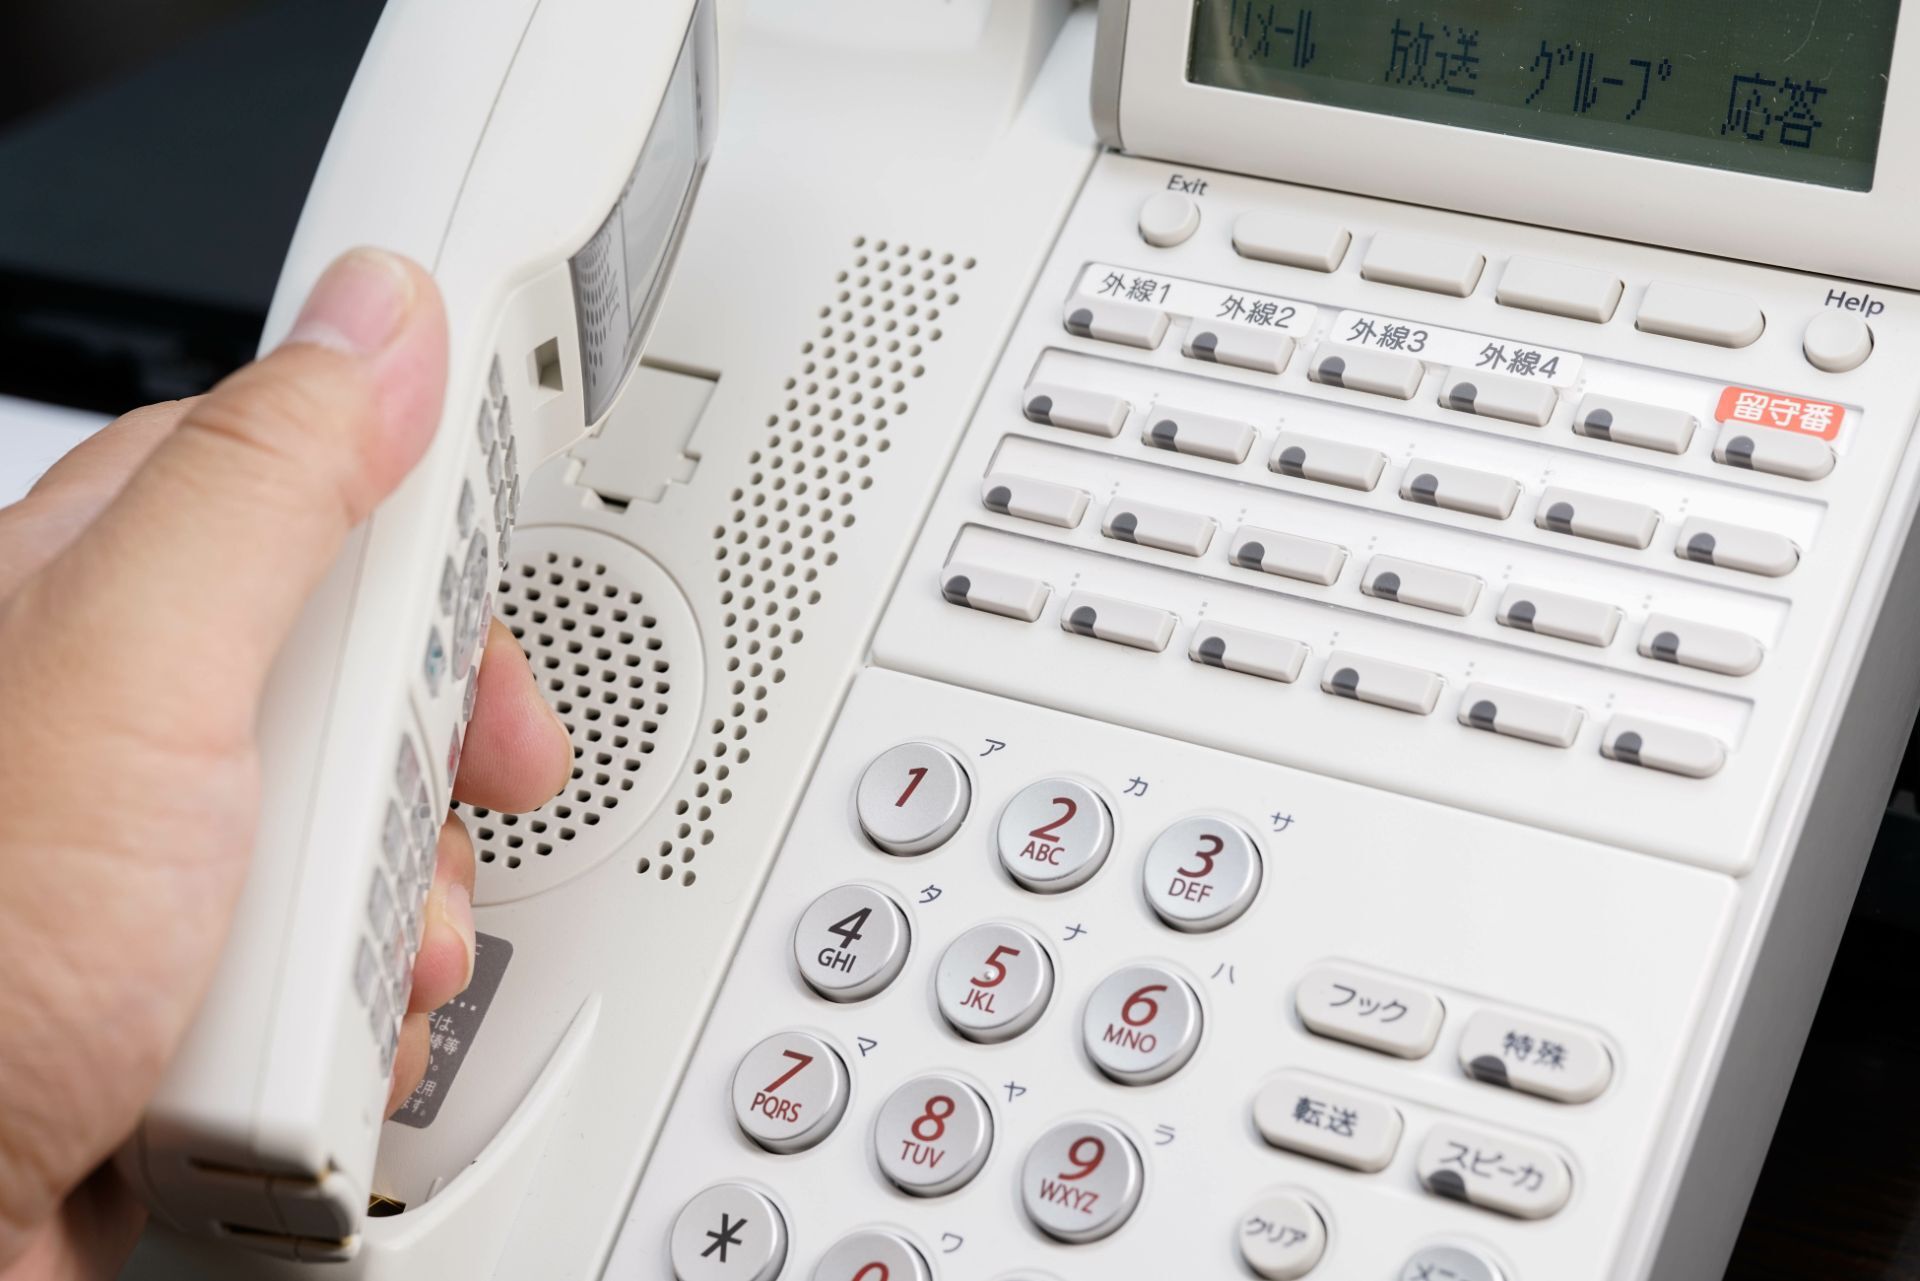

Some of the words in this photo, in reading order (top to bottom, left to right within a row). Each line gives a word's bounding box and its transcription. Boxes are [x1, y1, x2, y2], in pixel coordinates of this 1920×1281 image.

[1385, 19, 1479, 95] 放送
[1721, 73, 1827, 148] 応答
[1167, 174, 1208, 198] Exit
[1100, 271, 1172, 304] 外線1
[1824, 289, 1884, 319] Help
[1215, 294, 1297, 330] 外線2
[1348, 317, 1427, 355] 外線3
[1476, 342, 1560, 381] 外線4
[1733, 391, 1834, 433] 留守番
[980, 739, 1006, 756] ア
[896, 768, 928, 807] 1
[1124, 777, 1148, 796] カ
[1028, 797, 1077, 844] 2
[1272, 812, 1294, 832] サ
[1020, 841, 1065, 866] ABC
[1178, 834, 1224, 879] 3
[919, 885, 942, 903] タ
[1168, 878, 1214, 903] DEF
[827, 907, 873, 950] 4
[1064, 924, 1087, 940] ナ
[817, 948, 857, 974] GHI
[970, 945, 1020, 988] 5
[1212, 963, 1234, 984] ハ
[960, 988, 997, 1014] JKL
[1120, 984, 1168, 1027] 6
[1329, 983, 1407, 1024] フック
[858, 1037, 877, 1056] マ
[1103, 1023, 1157, 1053] MNO
[1502, 1030, 1568, 1070] 特殊
[763, 1050, 814, 1093] 7
[750, 1091, 802, 1124] PQRS
[1004, 1082, 1026, 1102] ヤ
[910, 1095, 956, 1142] 8
[1292, 1096, 1358, 1138] 転送
[1155, 1125, 1175, 1145] ラ
[901, 1140, 945, 1169] TUV
[1058, 1136, 1105, 1181] 9
[1439, 1140, 1544, 1192] スピーカ
[1039, 1178, 1099, 1214] WXYZ
[1245, 1216, 1308, 1248] クリア
